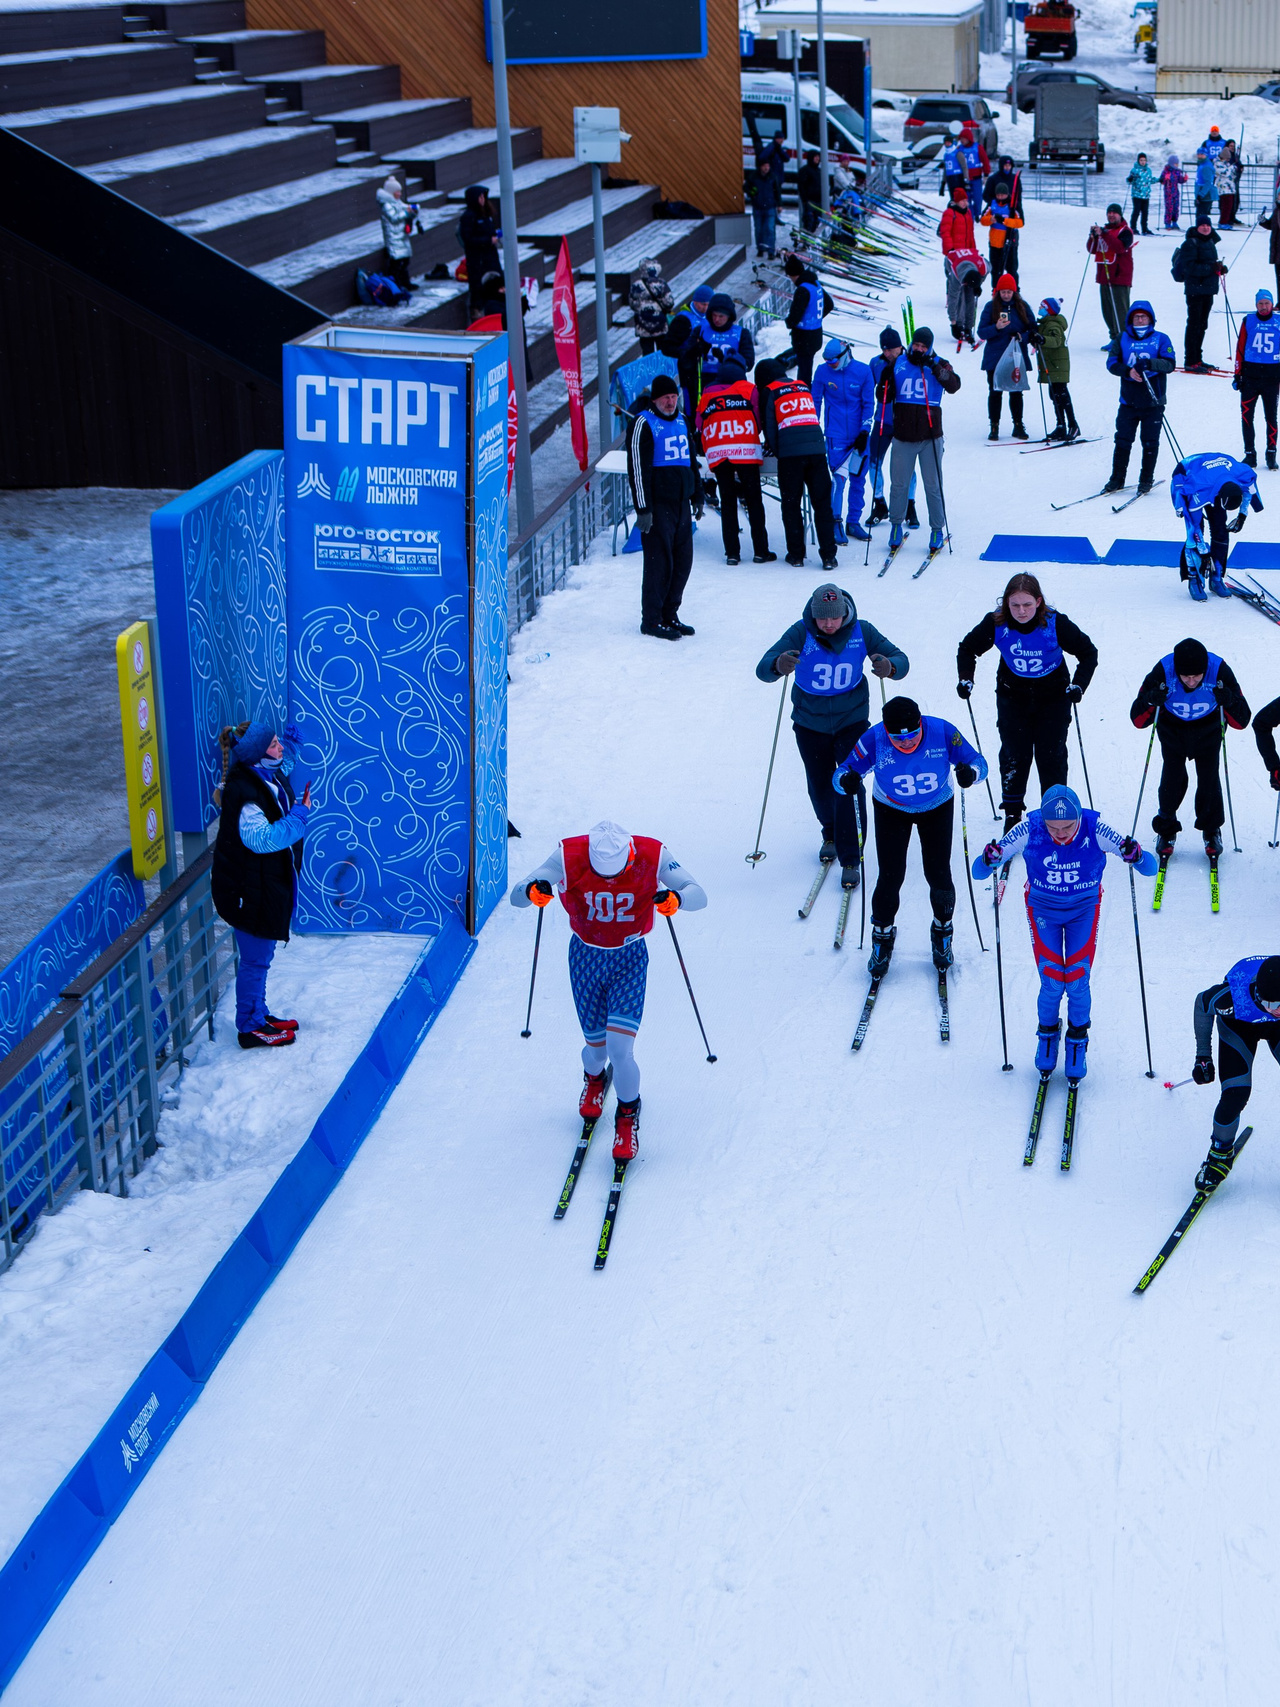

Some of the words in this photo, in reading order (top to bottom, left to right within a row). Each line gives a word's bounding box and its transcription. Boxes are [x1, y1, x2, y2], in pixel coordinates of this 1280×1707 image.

[1252, 333, 1274, 354] 45
[900, 377, 929, 399] 49
[296, 374, 459, 448] СТАРТ
[726, 399, 747, 408] Sport
[665, 435, 690, 461] 52
[366, 466, 457, 489] МОСКОВСКАЯ
[366, 486, 419, 505] ЛЫЖНЯ
[315, 524, 440, 543] ЮГО-ВОСТОК
[1013, 658, 1043, 672] 92
[812, 662, 853, 690] 30
[1172, 702, 1210, 719] 32
[892, 772, 939, 796] 33
[1058, 861, 1081, 870] МОЭК
[1046, 870, 1080, 884] 86
[1154, 883, 1164, 903] BRADOS
[583, 890, 635, 923] 102
[856, 1022, 868, 1040] TRAB
[933, 1014, 949, 1032] TRAB
[599, 1219, 611, 1250] FISCHER
[1138, 1254, 1165, 1290] FISCHER
[128, 1391, 160, 1443] МОСКОВСКИЙ
[134, 1427, 153, 1458] СПОРТ
